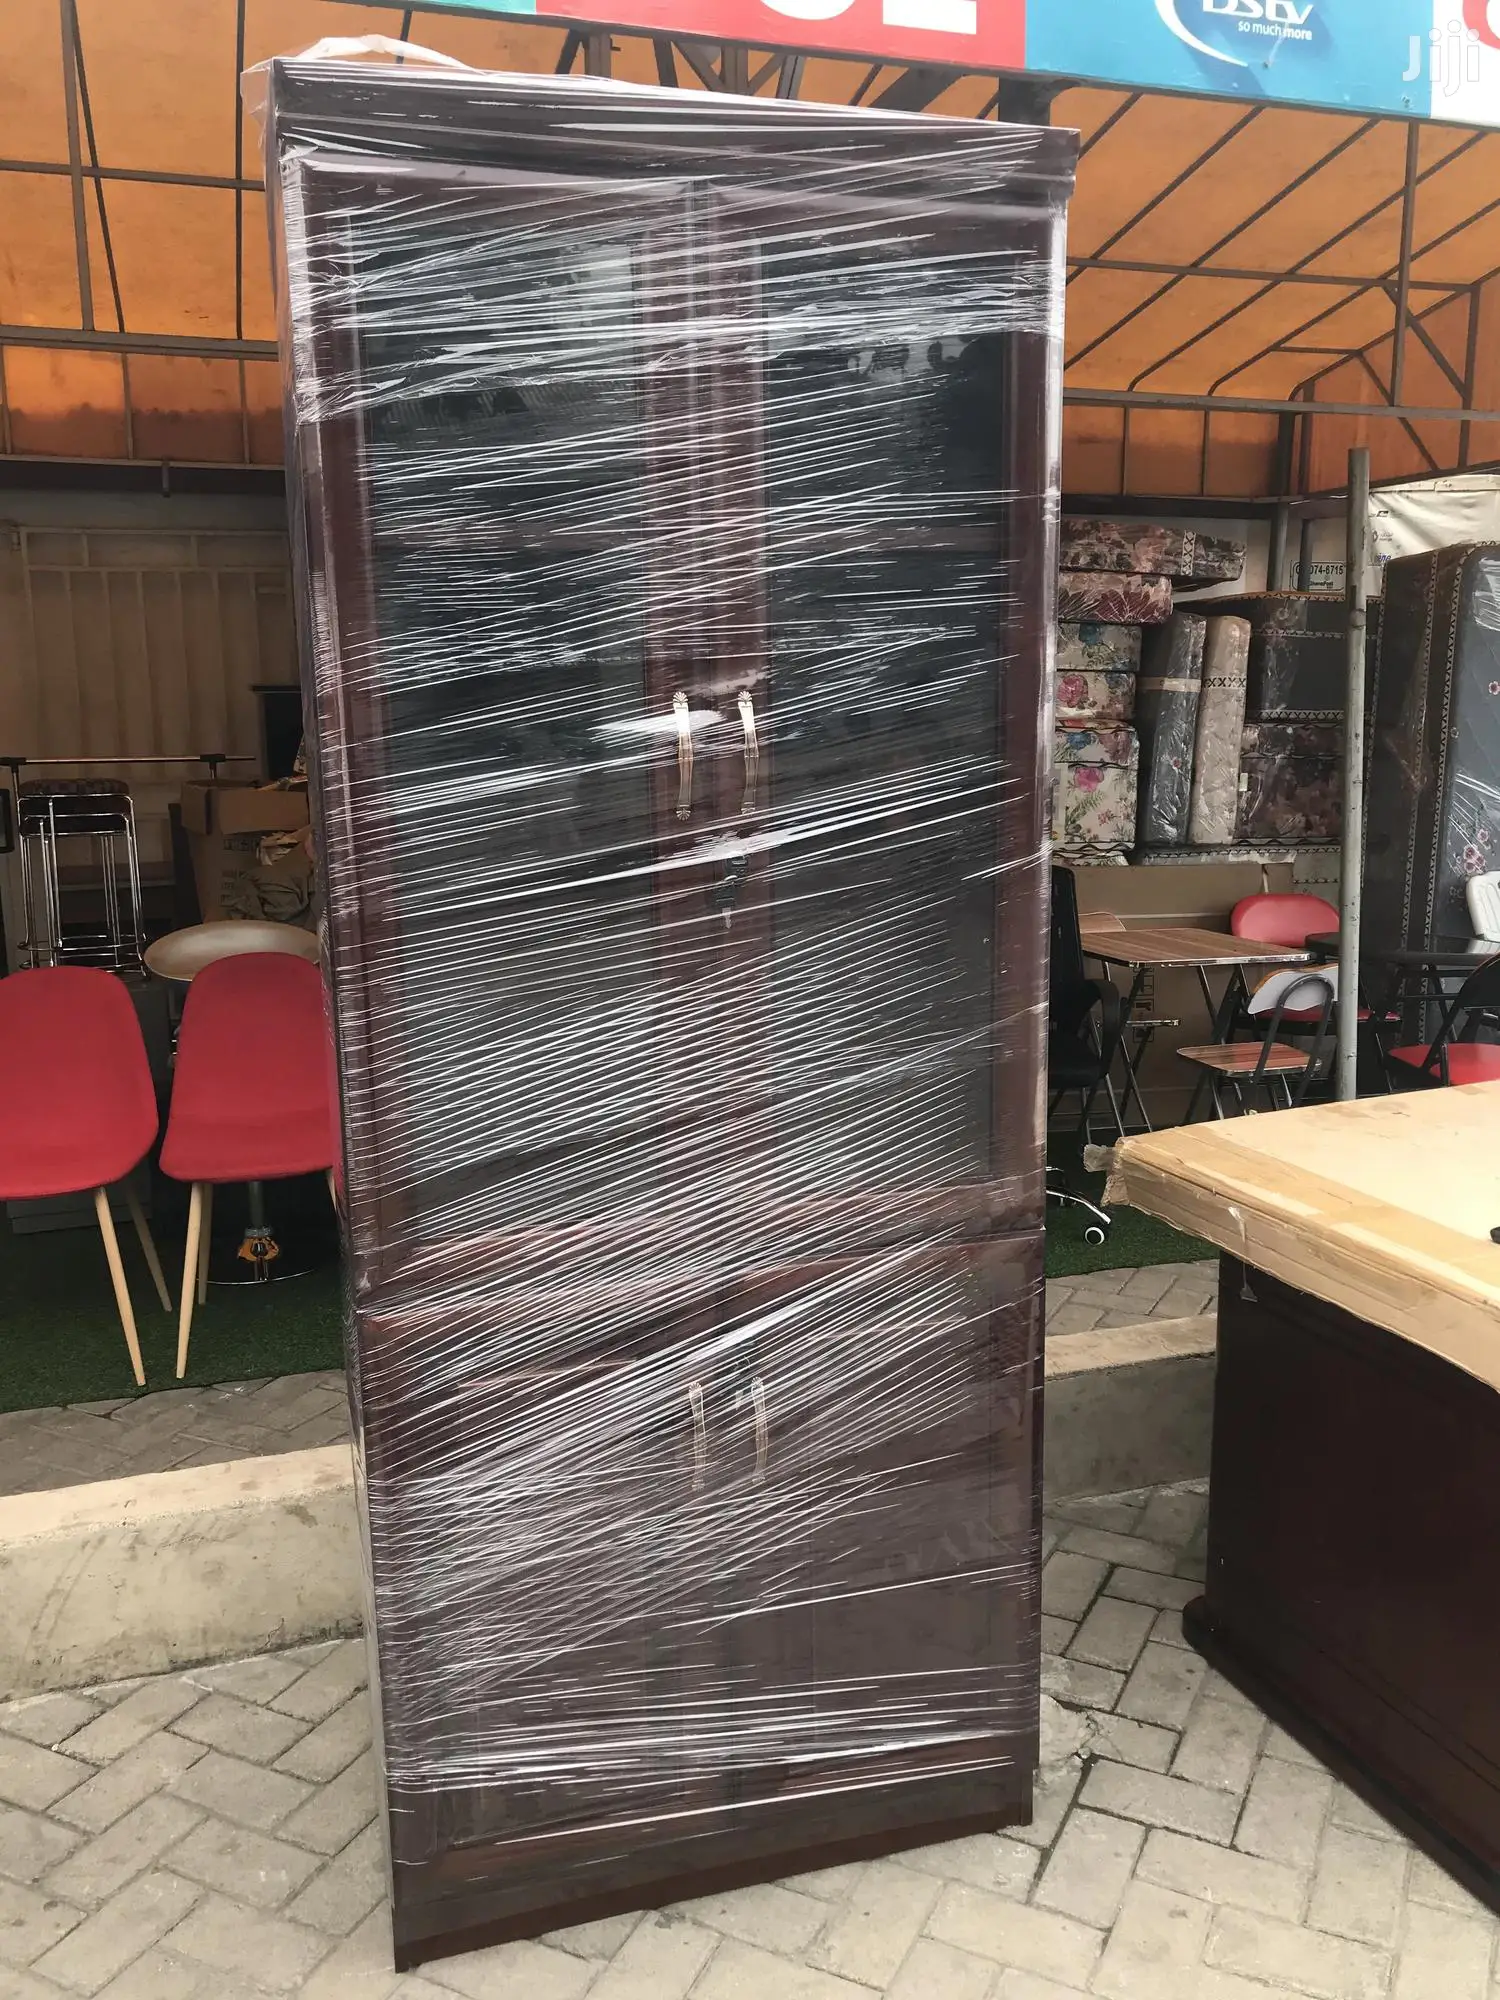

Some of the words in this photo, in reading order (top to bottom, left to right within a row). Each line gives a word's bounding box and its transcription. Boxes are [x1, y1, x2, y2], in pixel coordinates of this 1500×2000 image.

[1238, 21, 1250, 32] so
[1252, 23, 1281, 36] much
[1283, 28, 1312, 41] more
